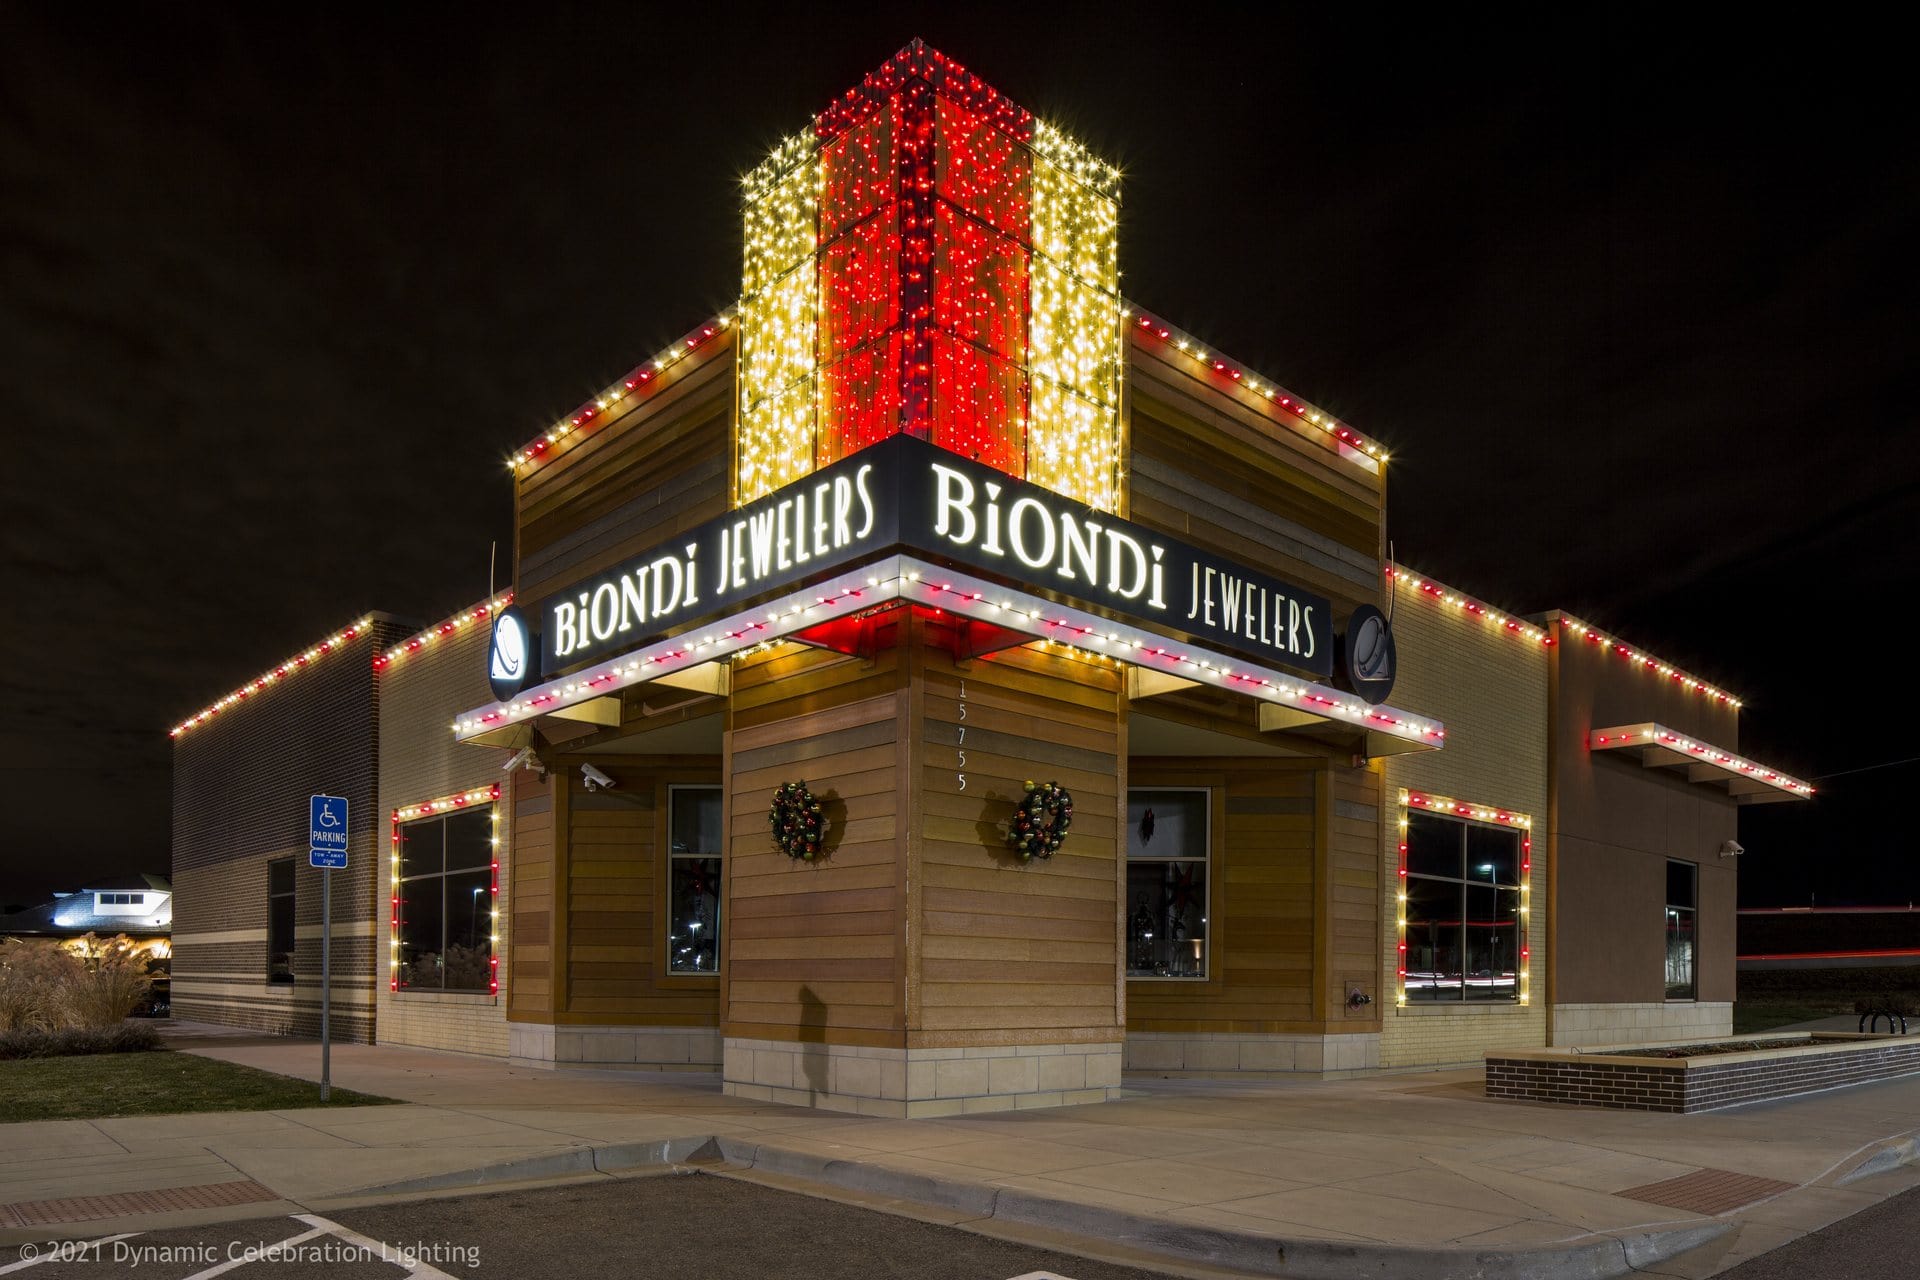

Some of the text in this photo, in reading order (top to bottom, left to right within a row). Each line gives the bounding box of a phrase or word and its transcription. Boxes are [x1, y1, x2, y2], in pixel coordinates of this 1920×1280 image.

[716, 463, 874, 595] JEWELERS
[1187, 560, 1315, 660] JEWELERS
[313, 831, 346, 843] PARKING
